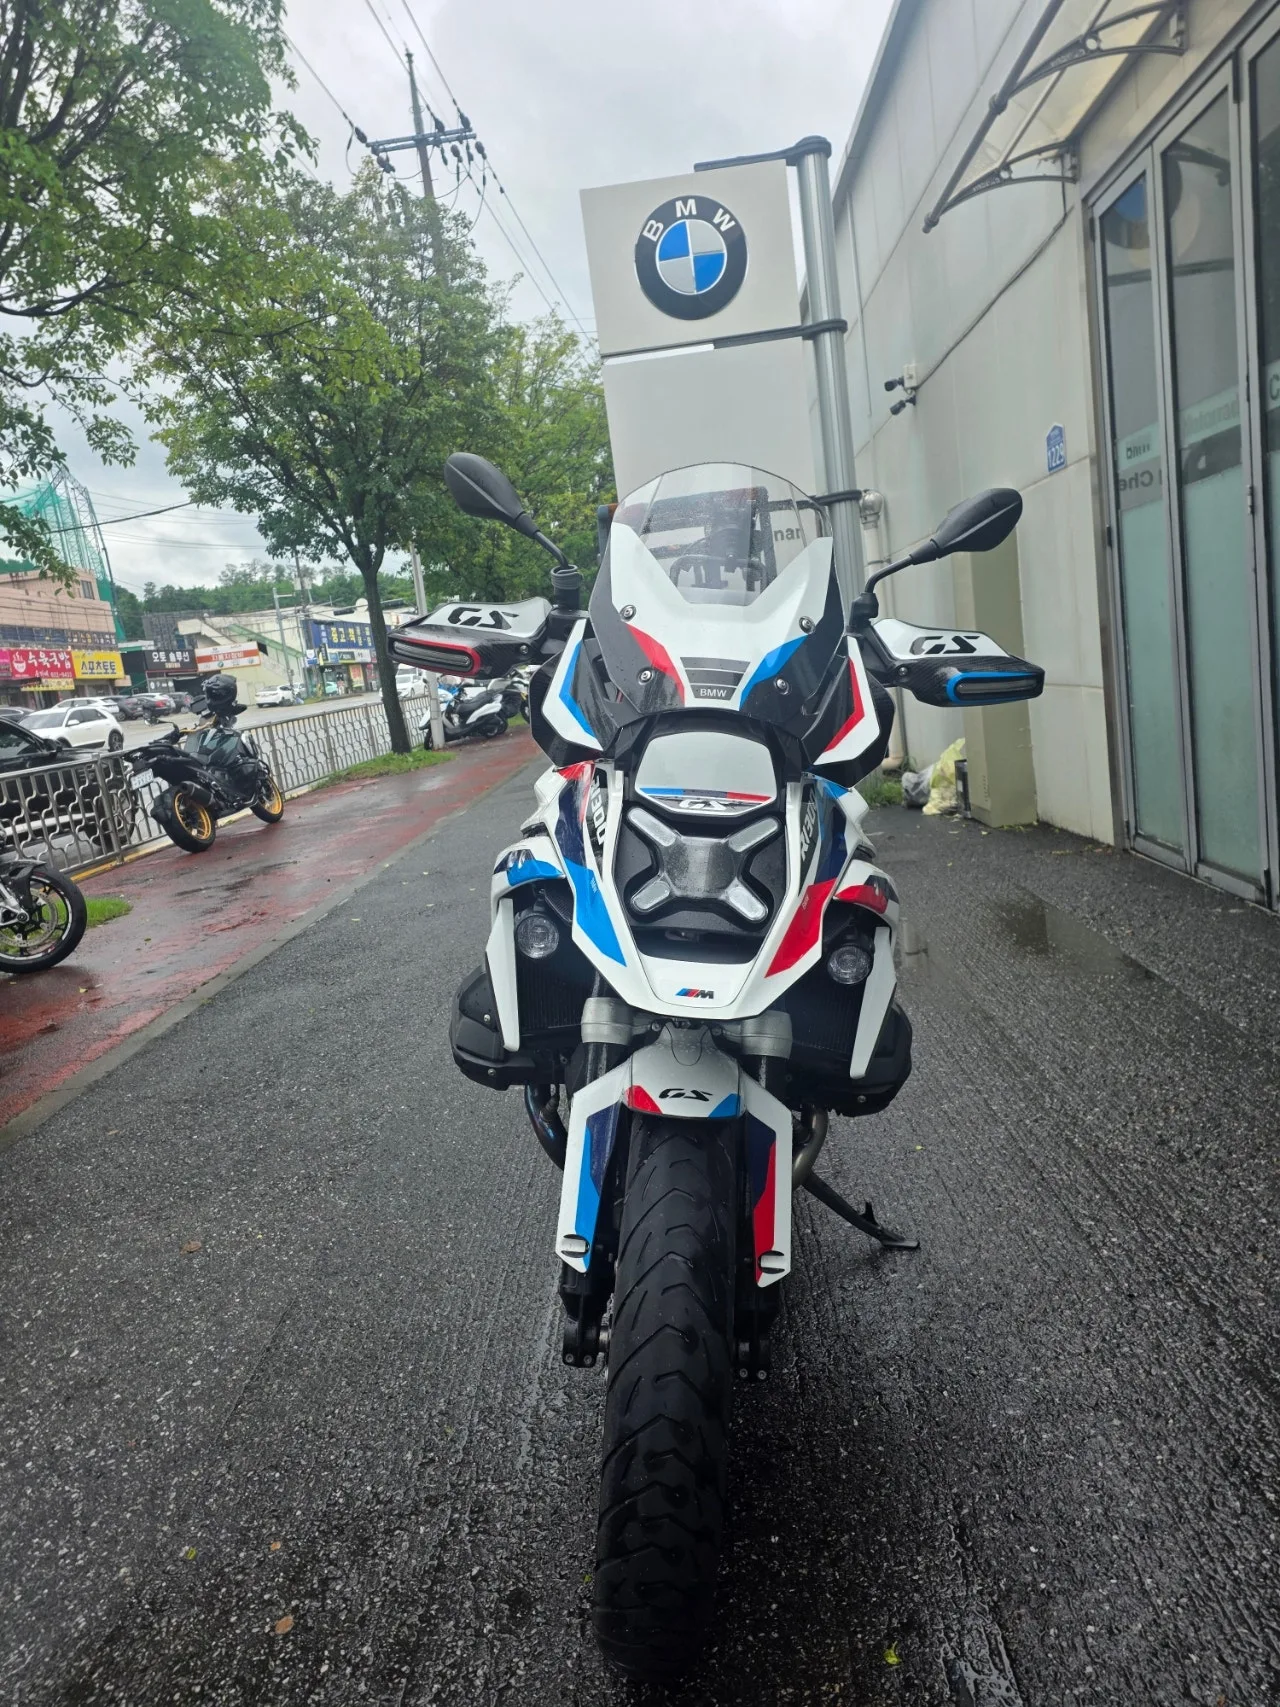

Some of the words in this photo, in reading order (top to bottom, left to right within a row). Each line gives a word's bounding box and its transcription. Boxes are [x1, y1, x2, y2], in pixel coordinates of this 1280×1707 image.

[642, 198, 737, 242] BMW
[447, 606, 520, 630] GS
[909, 635, 980, 655] GS
[27, 650, 72, 669] 수육국밥
[152, 651, 167, 663] 오토
[168, 651, 190, 663] 솔루션
[81, 661, 117, 675] 스포츠토토
[699, 688, 728, 699] BMW
[658, 1087, 713, 1102] GS
